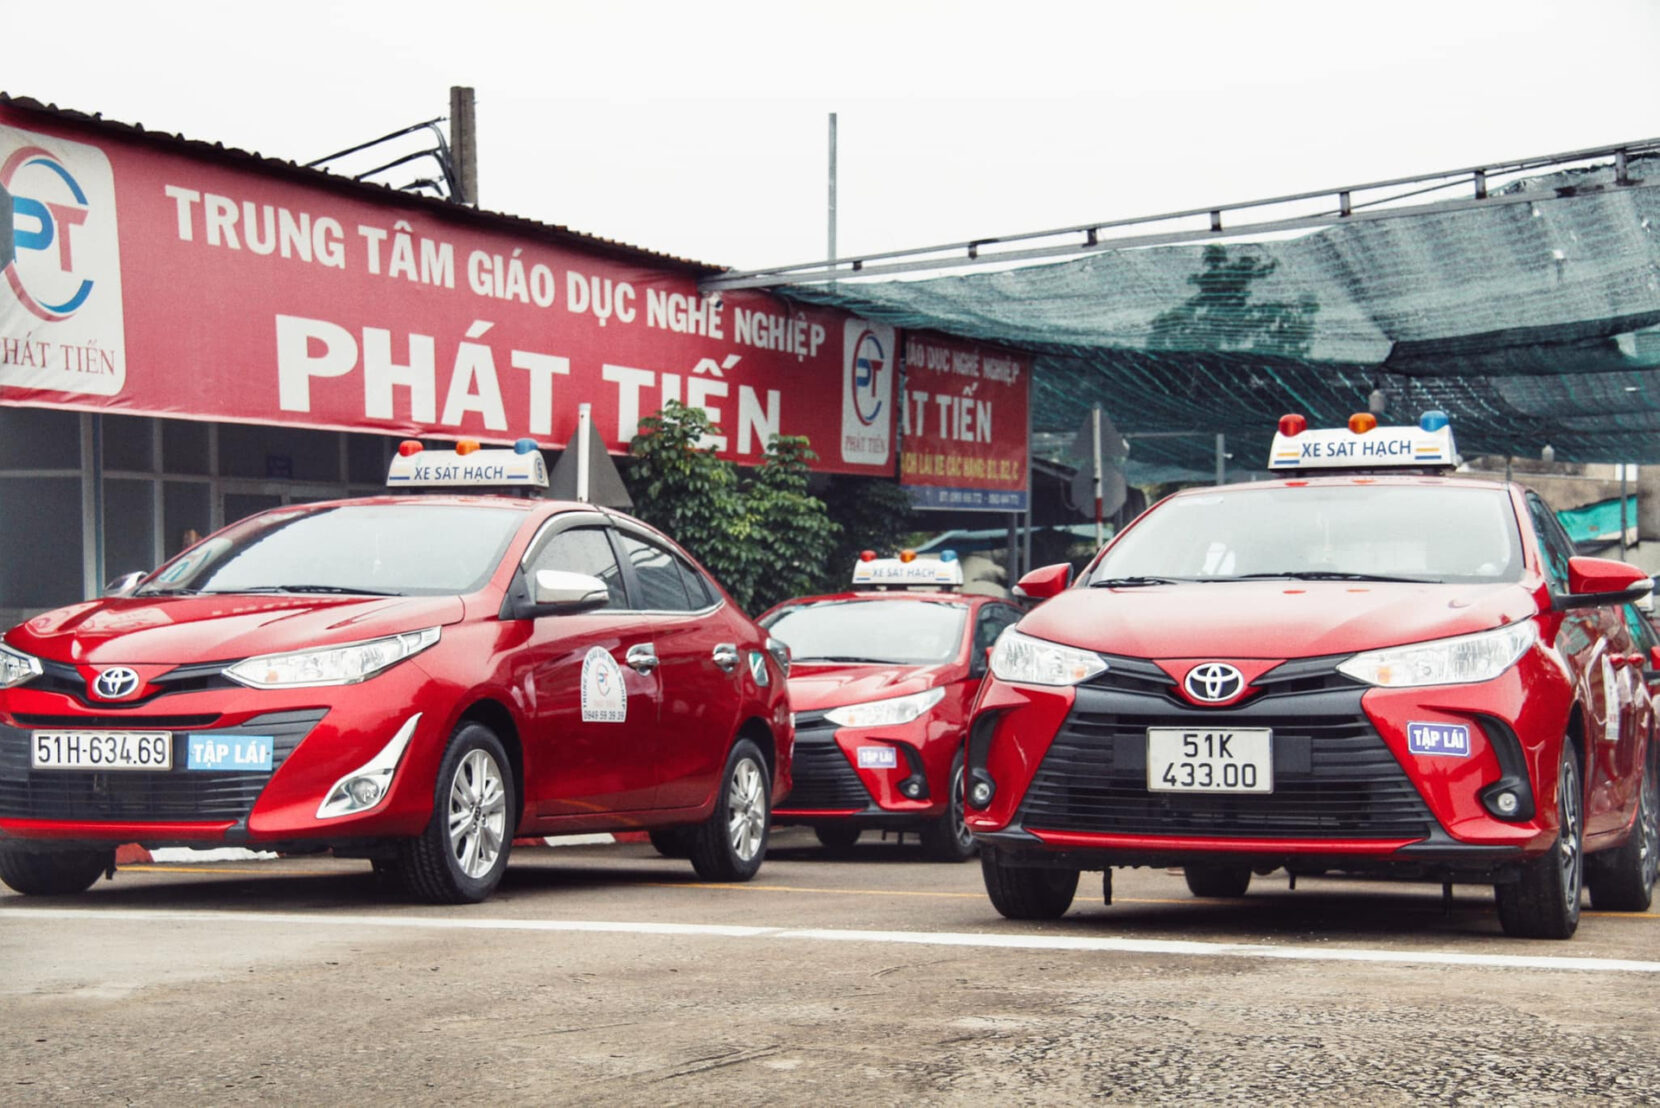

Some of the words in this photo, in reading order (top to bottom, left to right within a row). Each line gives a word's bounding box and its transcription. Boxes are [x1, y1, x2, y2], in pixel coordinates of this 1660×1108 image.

[165, 184, 346, 269] TRUNG
[358, 220, 455, 289] TÂM
[467, 248, 555, 308] GIÁO
[566, 270, 636, 327] DỤC
[734, 308, 825, 362] NGHIỆP
[3, 331, 50, 369] HÁT
[60, 339, 115, 376] TIẾN
[275, 314, 570, 435] PHÁT
[935, 382, 992, 444] TIẾN
[1301, 442, 1321, 458] XE
[414, 466, 430, 480] XE
[38, 736, 166, 765] 51H-634.69
[1184, 734, 1233, 758] 51K
[1413, 727, 1440, 750] TẬP
[1443, 729, 1464, 749] LÁI
[193, 740, 229, 768] TẬP
[235, 740, 266, 764] LÁI
[1163, 762, 1256, 787] 433.00
